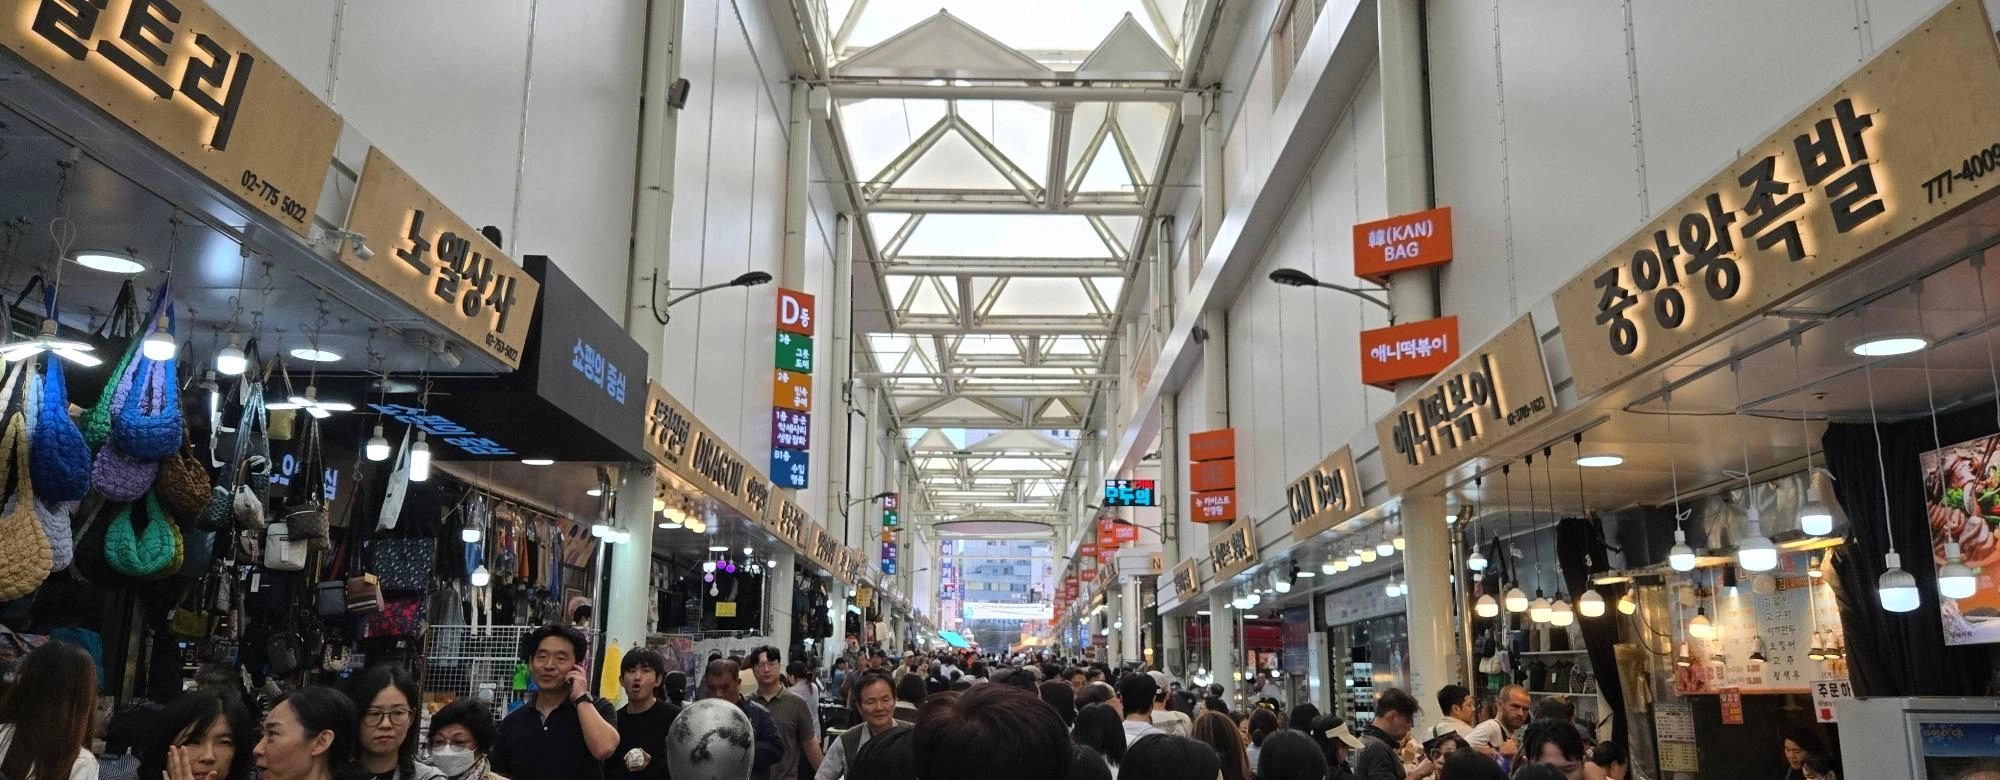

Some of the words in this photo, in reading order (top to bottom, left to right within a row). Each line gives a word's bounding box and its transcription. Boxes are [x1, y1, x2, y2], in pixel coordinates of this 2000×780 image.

[241, 170, 279, 205] 02-775
[281, 196, 307, 224] 5022
[1594, 98, 1886, 356] 중앙왕족발
[1384, 242, 1419, 262] BAG
[781, 295, 810, 328] D동
[779, 333, 791, 345] 3층
[1370, 334, 1448, 363] 애니떡볶이
[572, 337, 605, 389] 쇼핑의
[607, 362, 626, 405] 중심
[1392, 353, 1501, 465] 애니떡볶이
[778, 422, 807, 436] 악세사리
[692, 431, 744, 496] DRAGON
[774, 449, 791, 462] B1층
[790, 463, 805, 475] 수입
[790, 474, 805, 486] 명품
[1286, 476, 1316, 525] KAN
[1313, 468, 1347, 511] Bag
